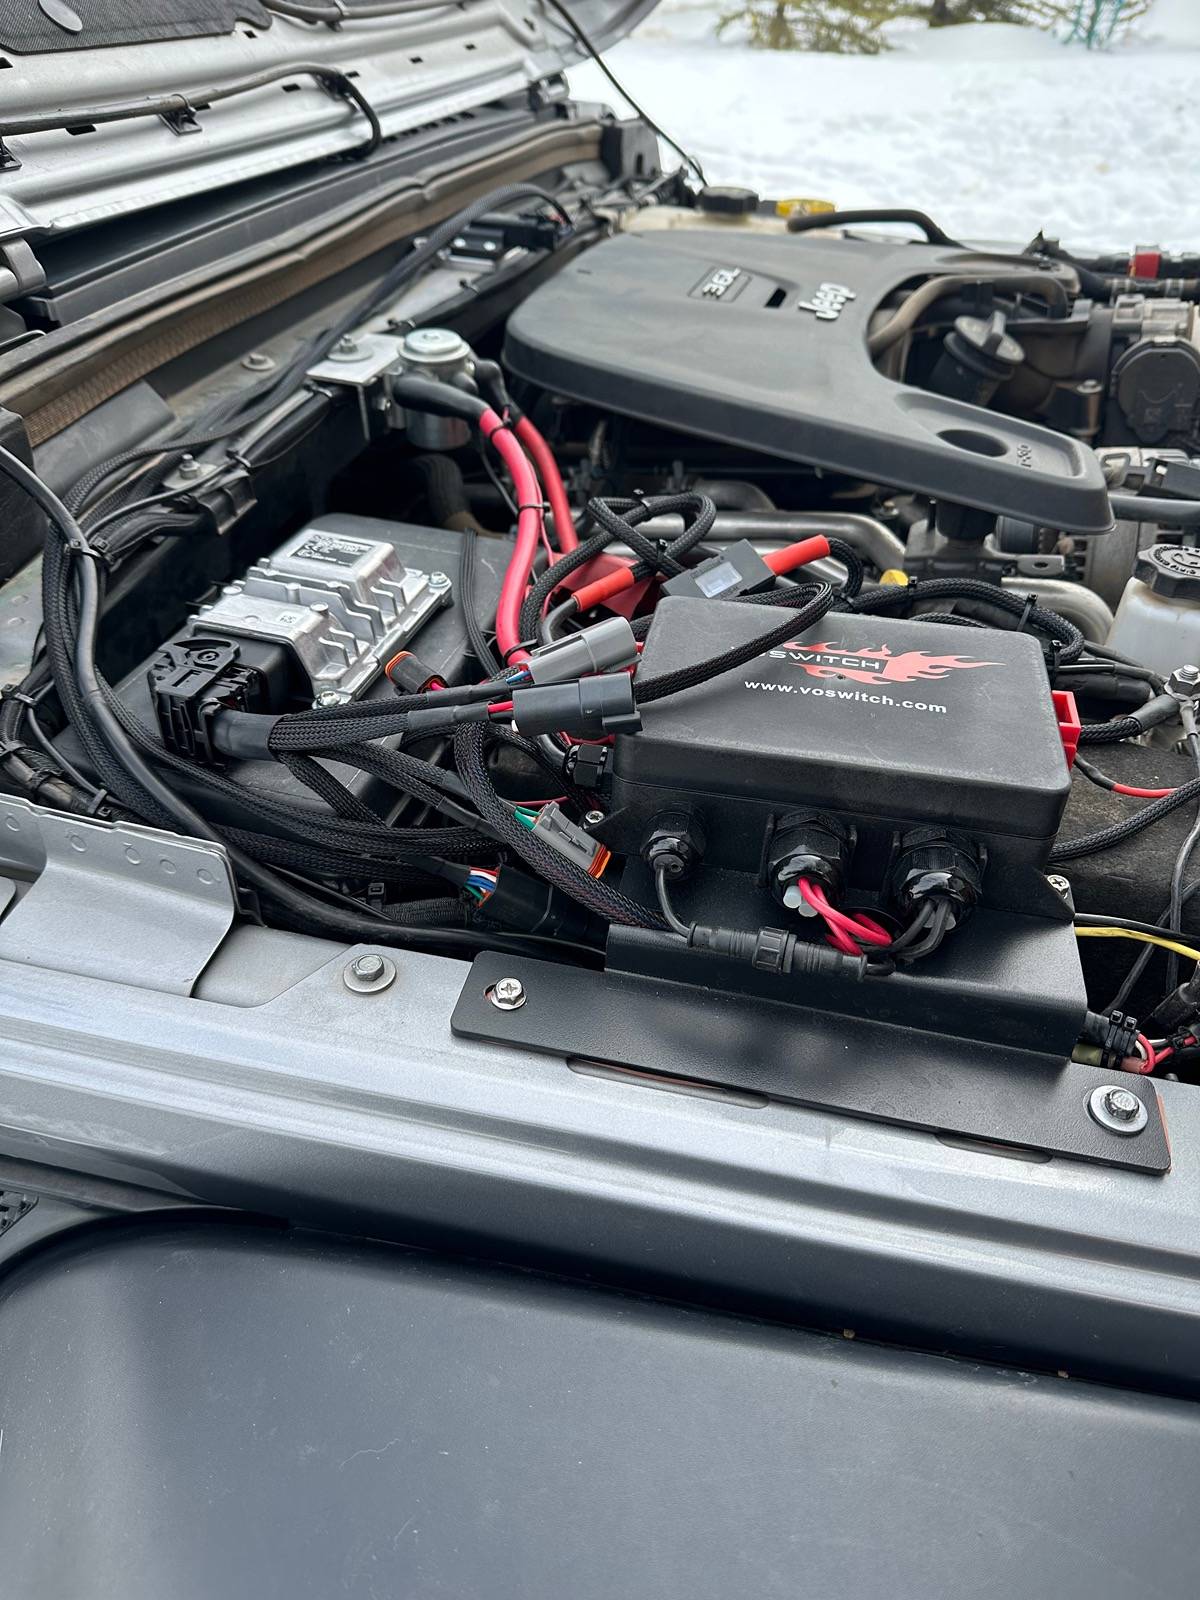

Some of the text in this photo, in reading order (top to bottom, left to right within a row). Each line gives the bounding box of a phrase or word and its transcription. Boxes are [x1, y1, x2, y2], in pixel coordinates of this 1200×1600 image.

[798, 282, 857, 321] Jeep
[732, 647, 880, 670] SWITCH
[744, 681, 947, 713] www.voswitch.com
